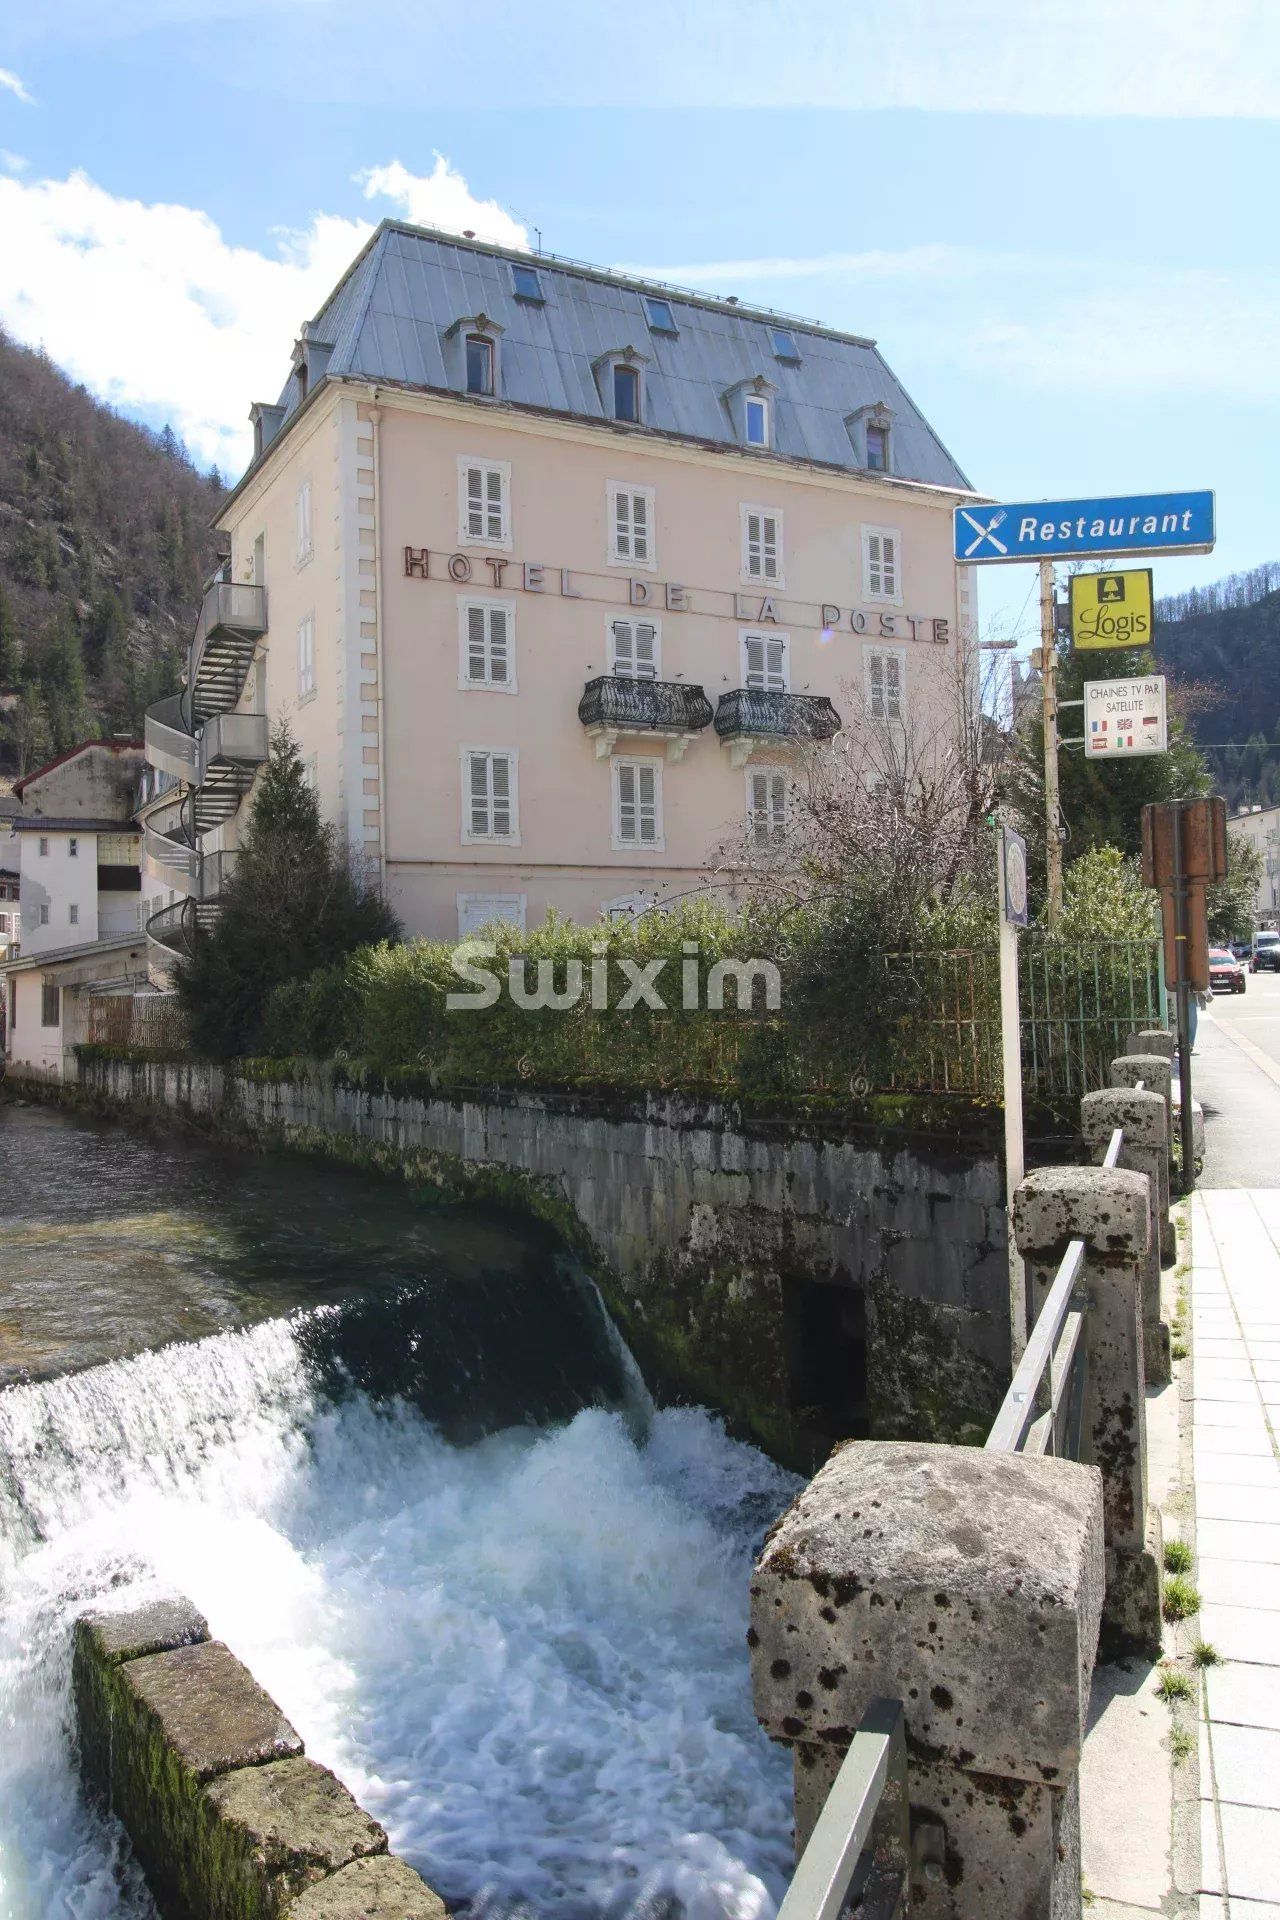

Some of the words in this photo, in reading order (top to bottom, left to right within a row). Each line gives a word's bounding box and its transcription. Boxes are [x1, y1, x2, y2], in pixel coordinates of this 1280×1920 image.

[1018, 509, 1193, 542] Restaurant
[404, 546, 582, 599] HOTEL
[629, 576, 689, 613] DE
[733, 592, 780, 624] LA
[821, 603, 949, 645] POSTE
[1077, 604, 1148, 641] Logis
[1090, 686, 1128, 699] CHAINES
[1131, 685, 1142, 696] TV
[1144, 683, 1159, 695] PAR
[1106, 700, 1144, 713] SATELLITE
